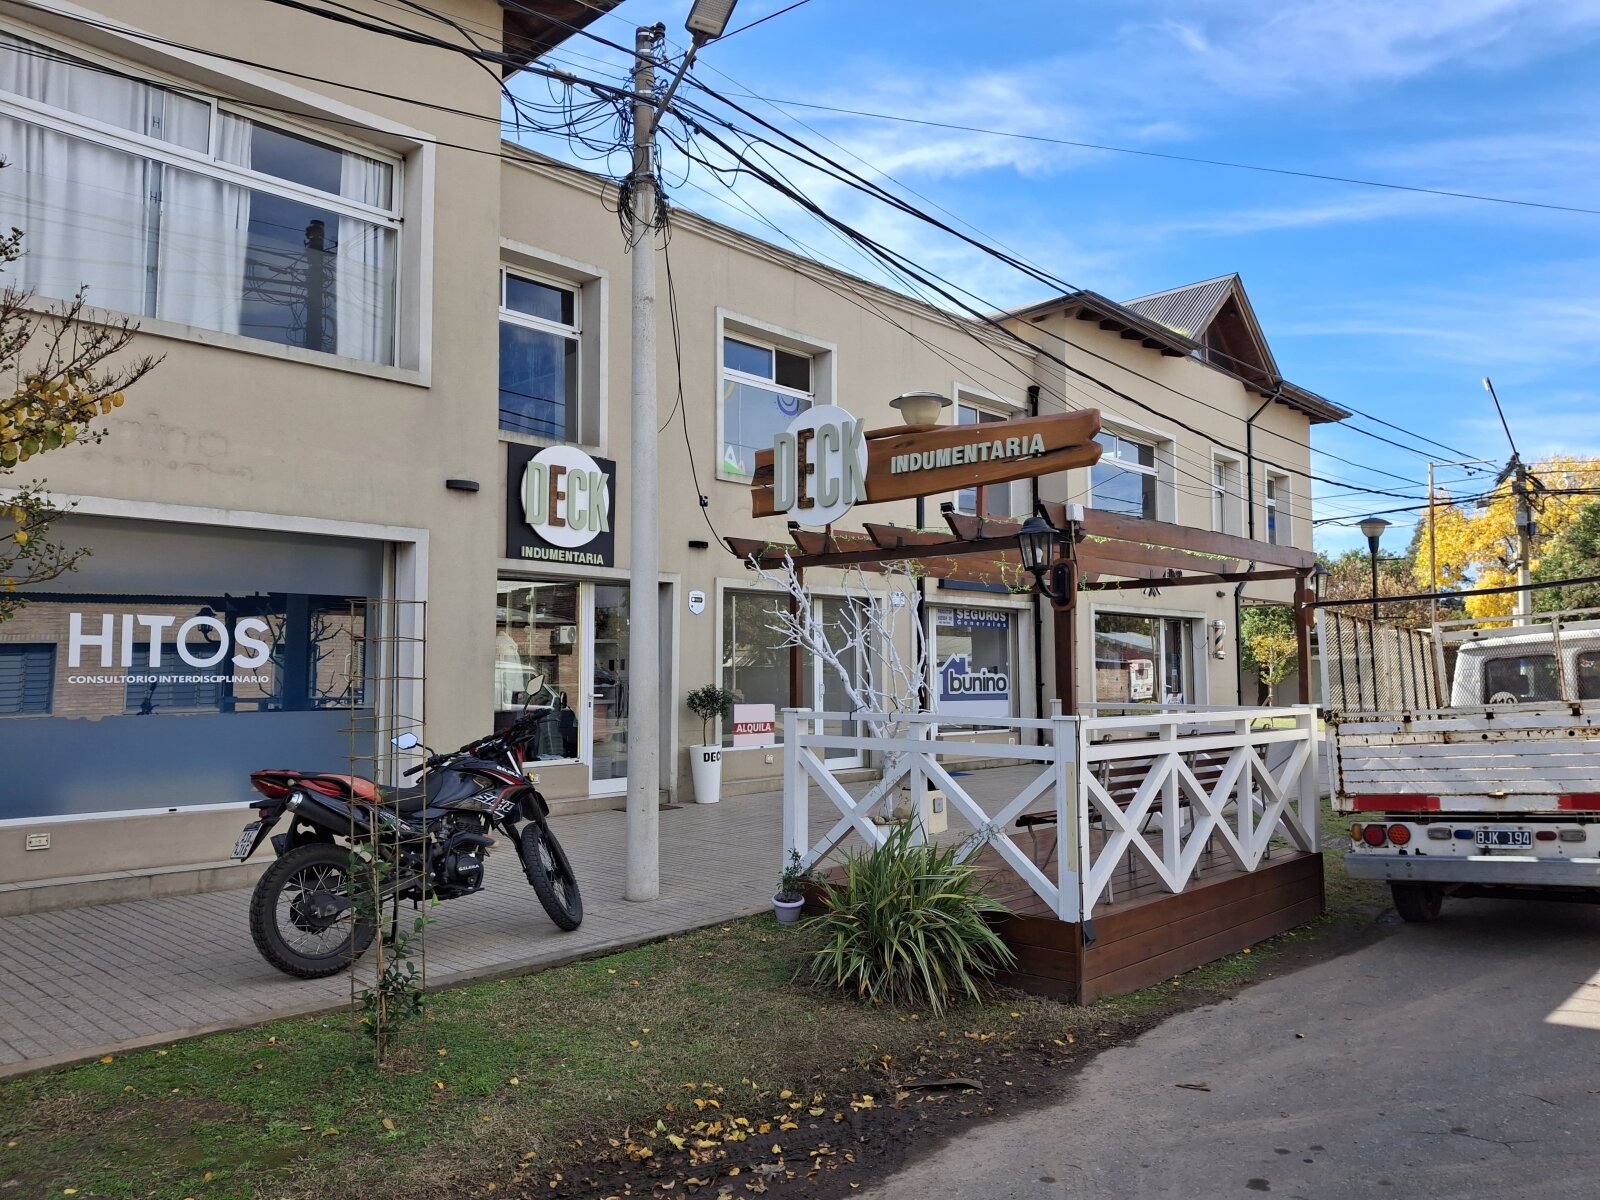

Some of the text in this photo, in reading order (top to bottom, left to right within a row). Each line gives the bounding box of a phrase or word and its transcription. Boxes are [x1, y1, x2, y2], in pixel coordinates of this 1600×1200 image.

[773, 417, 1045, 512] DECK INDUMENTARIA
[525, 460, 610, 533] DECK
[521, 545, 604, 565] INDUMENTARIA
[957, 609, 1007, 622] SEGUROS
[957, 620, 1007, 628] Generales
[68, 612, 270, 668] HITOS
[68, 675, 270, 684] CONSULTORIO INTERDISCIPLINARIO
[949, 670, 1007, 692] bunino
[736, 722, 772, 733] ALQUILA
[1477, 831, 1530, 845] BJK 194
